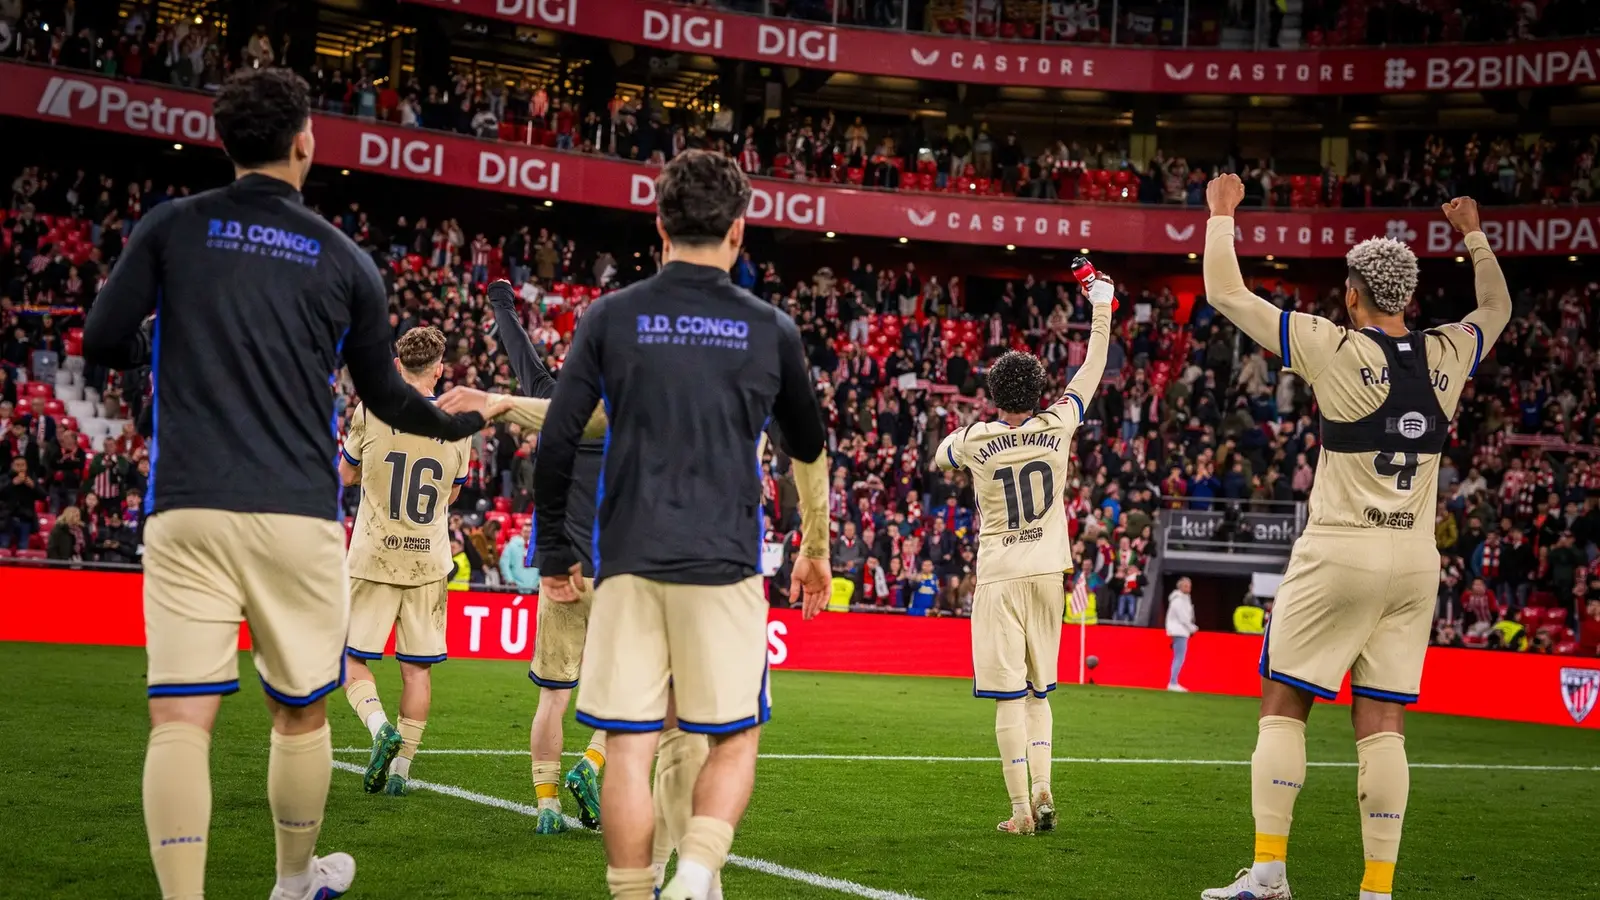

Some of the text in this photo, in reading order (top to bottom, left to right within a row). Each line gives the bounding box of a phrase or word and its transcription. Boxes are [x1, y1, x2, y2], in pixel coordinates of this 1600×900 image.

[643, 9, 724, 49] DIGI
[757, 24, 838, 62] DIGI
[951, 51, 1095, 76] CASTORE
[1206, 63, 1355, 81] CASTORE
[1426, 48, 1600, 89] B2BINPA
[359, 132, 444, 176] DIGI
[478, 151, 560, 193] DIGI
[746, 188, 826, 226] DIGI
[947, 212, 1093, 237] CASTORE
[247, 224, 321, 256] CONGO
[1234, 224, 1358, 244] ASTORE
[1427, 216, 1600, 253] BBINPA
[637, 315, 749, 339] R.D. CONGO
[973, 432, 1062, 465] LAMINE YAMAL
[383, 450, 443, 525] 16
[993, 461, 1054, 531] 10
[403, 543, 431, 551] ACNUR
[404, 536, 431, 545] UNHCR
